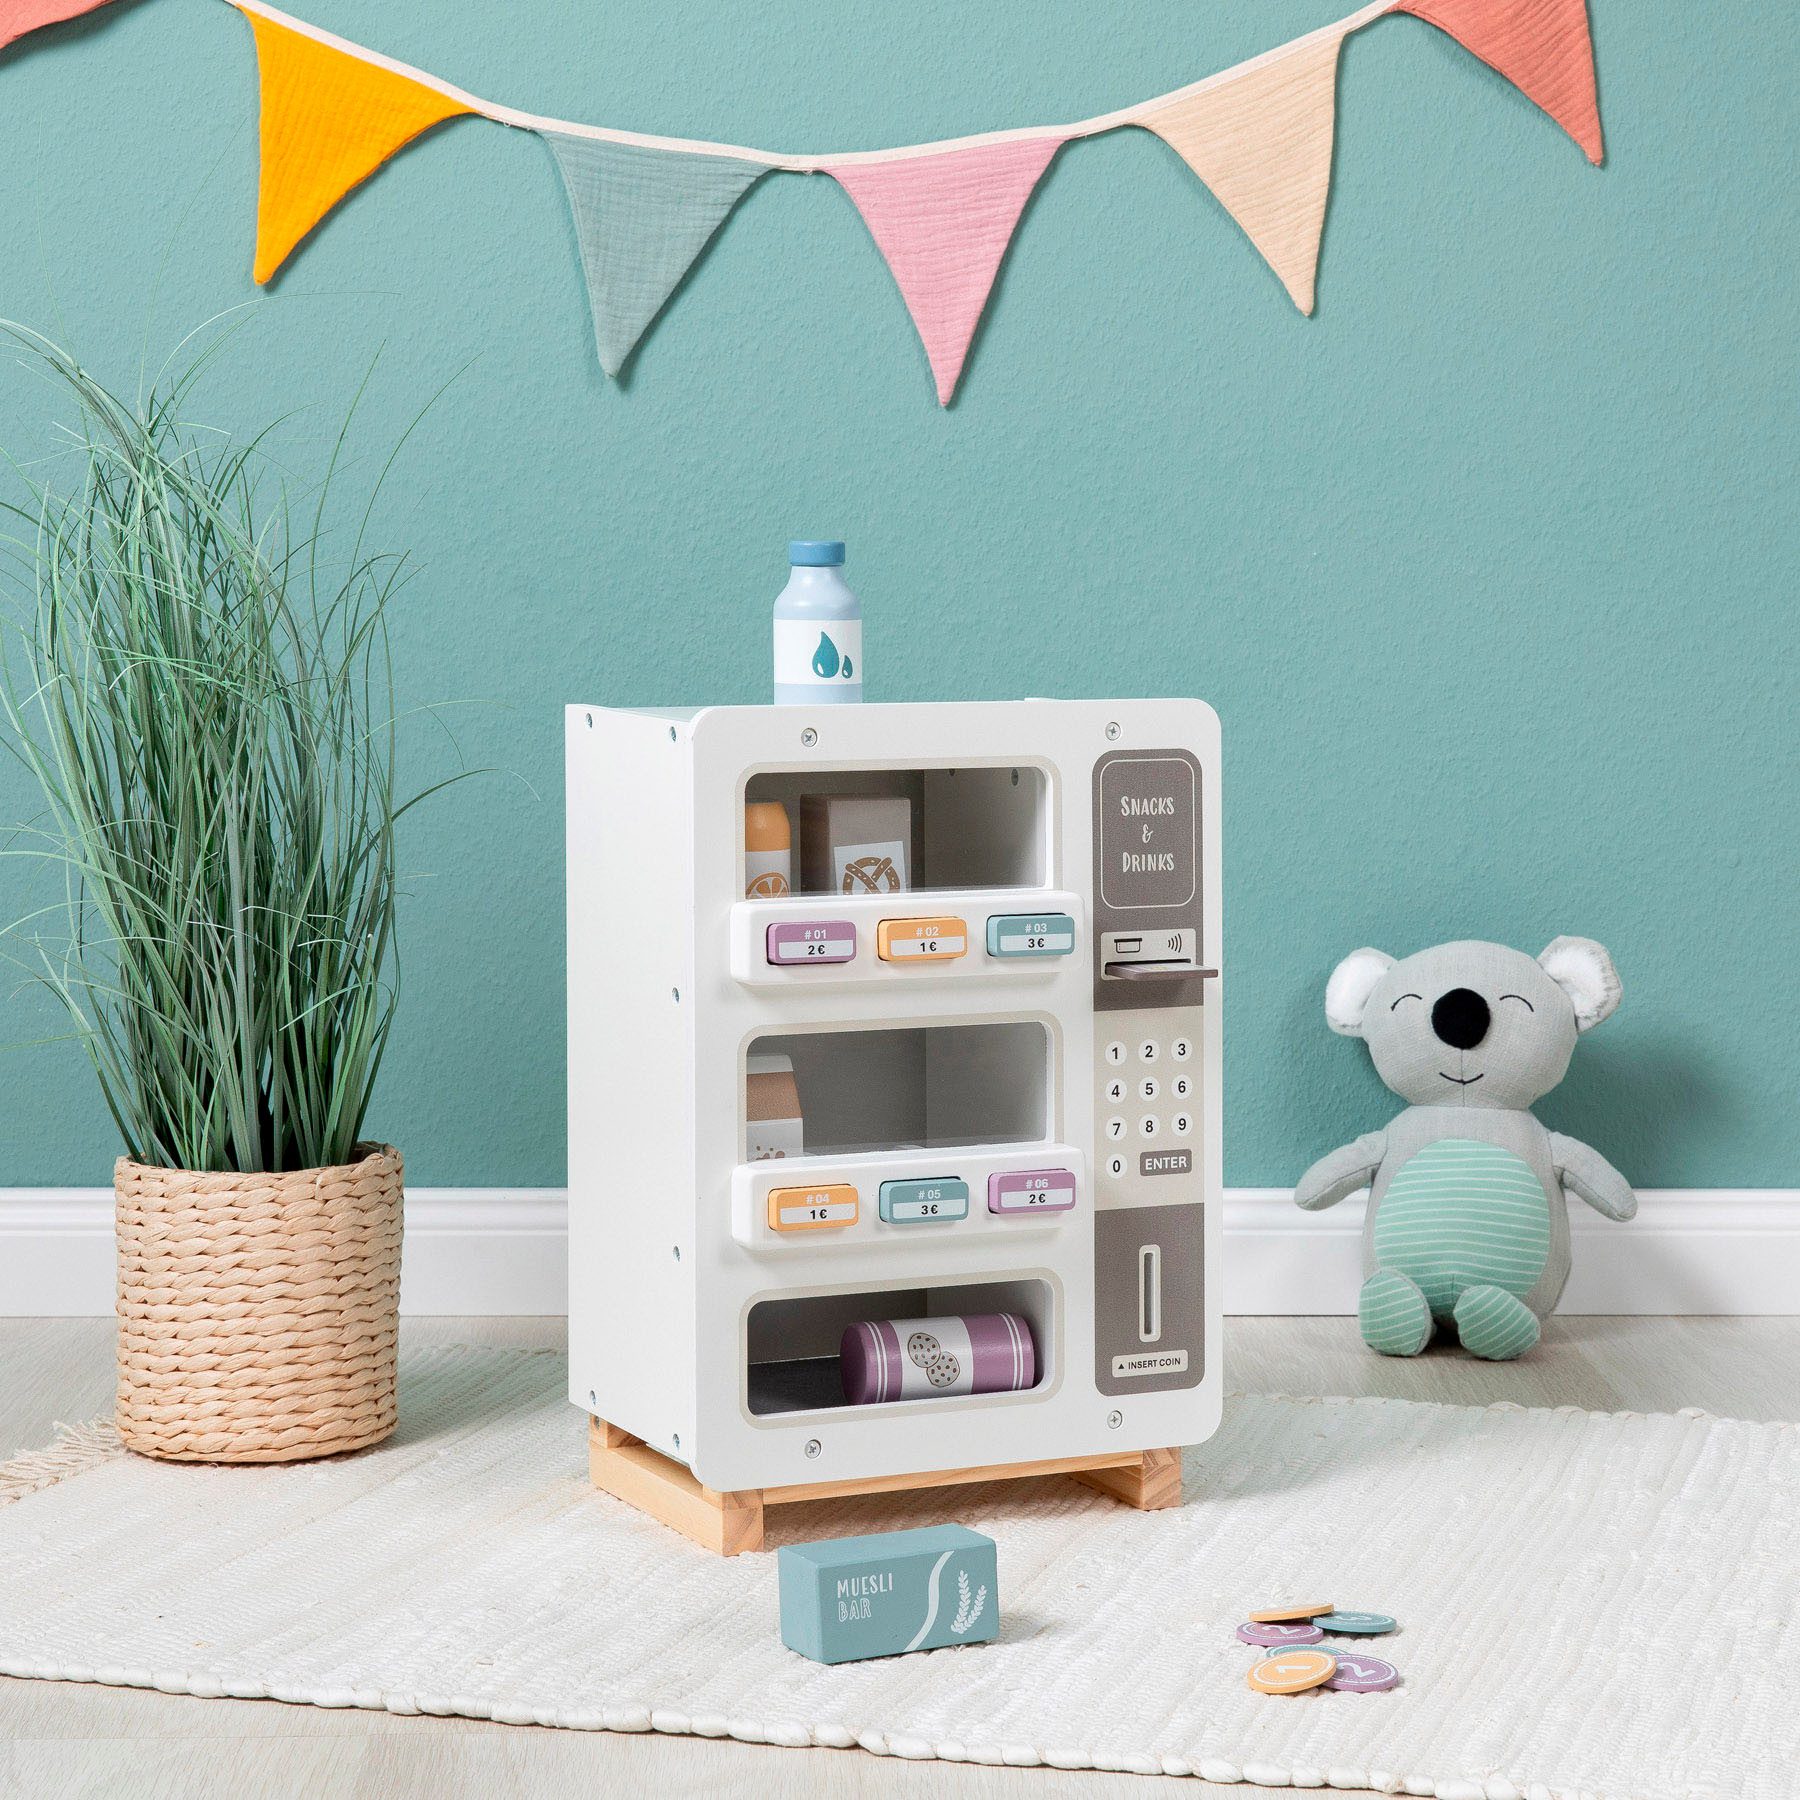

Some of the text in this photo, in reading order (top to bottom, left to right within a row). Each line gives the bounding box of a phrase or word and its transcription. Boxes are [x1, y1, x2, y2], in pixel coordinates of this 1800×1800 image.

[1120, 796, 1175, 817] SNACKS
[1142, 824, 1153, 843] &
[1122, 852, 1175, 873] DRINKS
[1112, 1043, 1186, 1059] 1 2 3
[1111, 1081, 1186, 1097] 4 5 6
[1113, 1118, 1186, 1135] 7 8 9
[1113, 1156, 1187, 1172] 0 ENTER
[1128, 1357, 1181, 1370] INSERT COIN
[837, 1572, 893, 1599] MUESLI
[838, 1598, 872, 1623] BAR
[1262, 1625, 1300, 1635] 2
[1275, 1665, 1313, 1674] 1
[1336, 1662, 1376, 1678] 2
